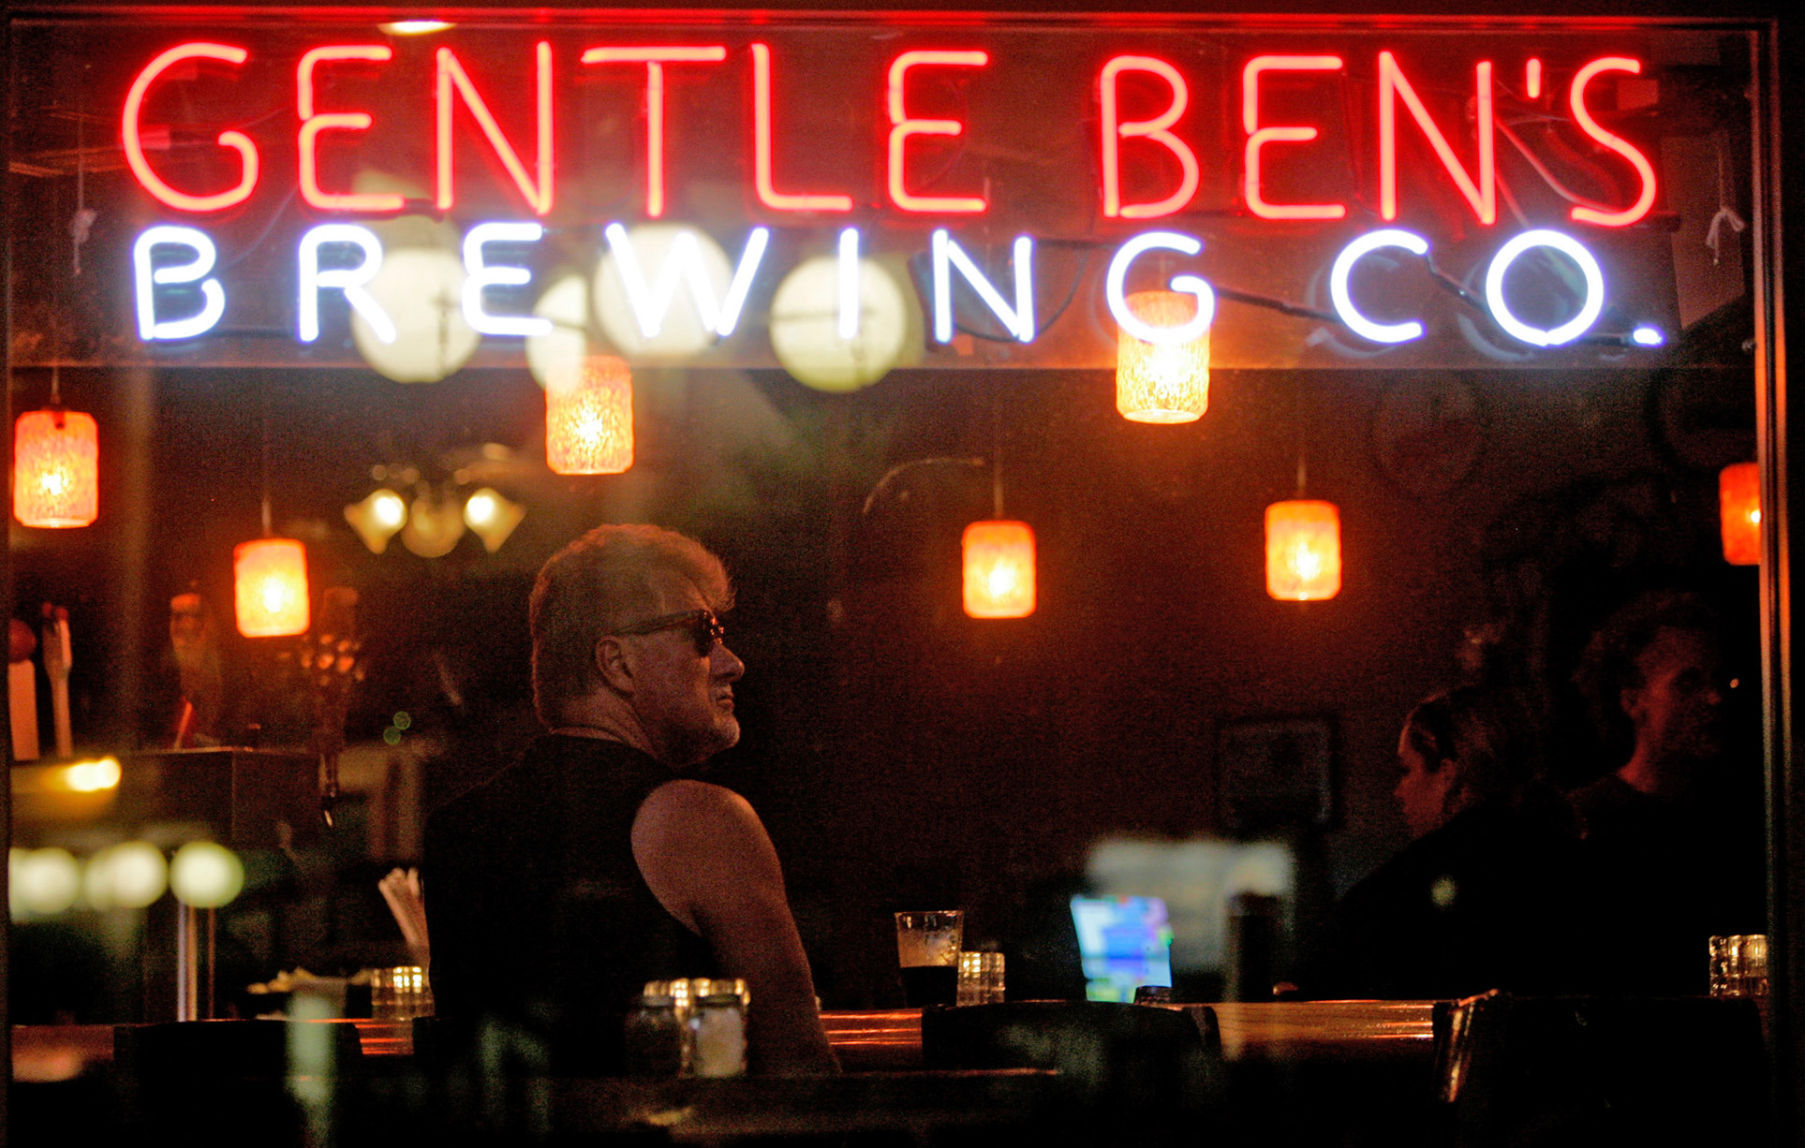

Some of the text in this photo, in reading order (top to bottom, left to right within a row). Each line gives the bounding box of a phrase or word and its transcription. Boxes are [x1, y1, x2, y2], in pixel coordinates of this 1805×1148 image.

[121, 41, 1657, 226] GENTLE BEN'S
[134, 222, 1664, 347] BREWING CO.
